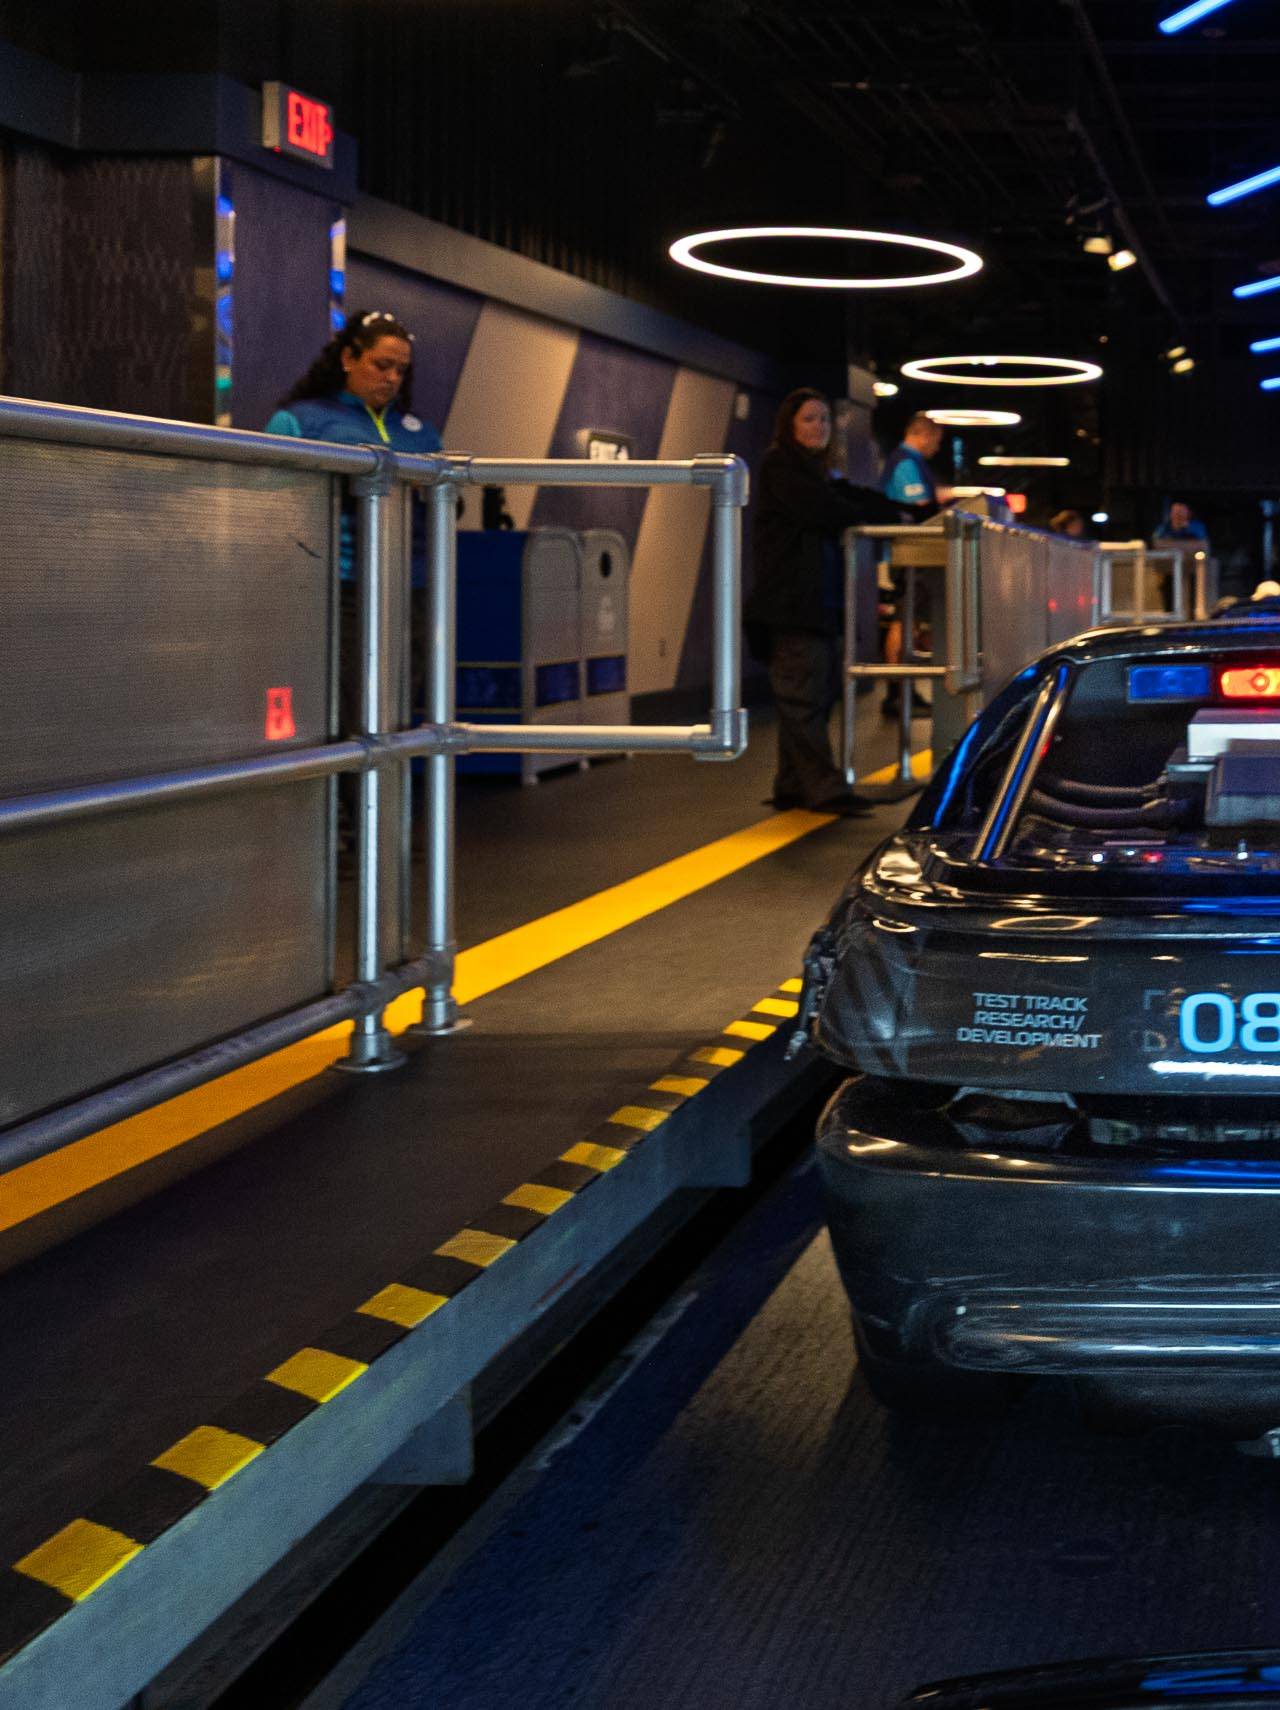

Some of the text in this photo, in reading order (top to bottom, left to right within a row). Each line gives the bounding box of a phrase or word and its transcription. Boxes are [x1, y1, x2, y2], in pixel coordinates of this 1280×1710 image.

[287, 91, 329, 157] EXIT
[972, 992, 1089, 1012] TEST TRACK
[972, 1010, 1086, 1032] RESEARCH/
[956, 1027, 1103, 1048] DEVELOPMENT
